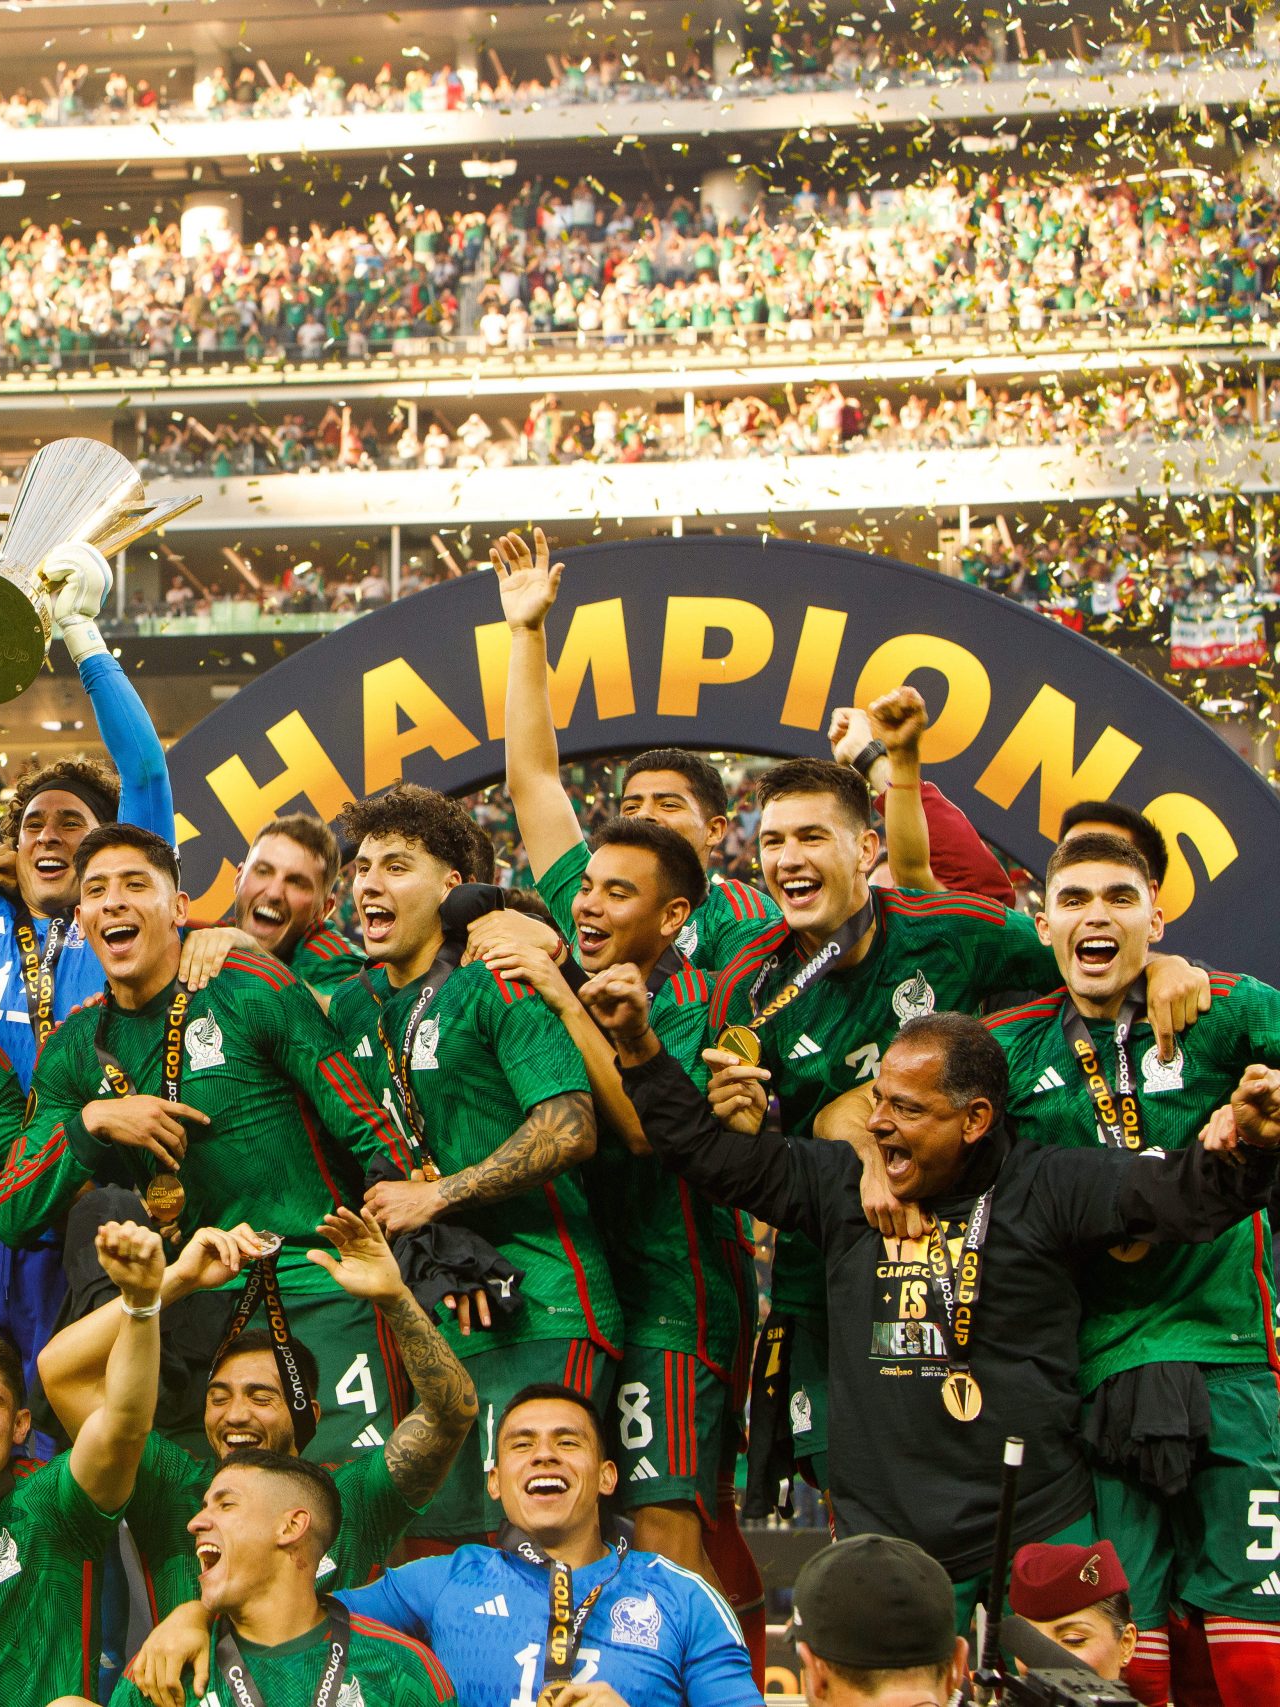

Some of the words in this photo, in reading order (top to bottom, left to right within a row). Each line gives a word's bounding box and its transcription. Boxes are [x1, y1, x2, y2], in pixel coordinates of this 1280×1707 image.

[17, 925, 35, 952] CUP
[40, 917, 64, 973] Concacaf
[38, 974, 52, 1019] GOLD
[169, 992, 188, 1026] CUP
[402, 986, 433, 1052] Concacaf
[39, 1020, 52, 1043] CU
[166, 1029, 181, 1079] GOLD
[1074, 1039, 1098, 1074] CUP
[105, 1063, 129, 1095] CUP
[1116, 1023, 1132, 1095] Concacaf
[1089, 1074, 1117, 1124] GOLD
[1121, 1096, 1141, 1149] GOLD
[899, 1281, 927, 1320] ES
[958, 1250, 978, 1304] GOLD
[267, 1294, 288, 1343] GOLD
[954, 1307, 971, 1346] CUP
[277, 1345, 307, 1411] Concacaf
[335, 1353, 377, 1415] 4
[617, 1381, 654, 1450] 8
[1245, 1489, 1280, 1562] 5
[553, 1572, 570, 1623] GOLD
[551, 1625, 568, 1665] CUP
[228, 1665, 255, 1707] Conc
[316, 1642, 344, 1707] Concaca
